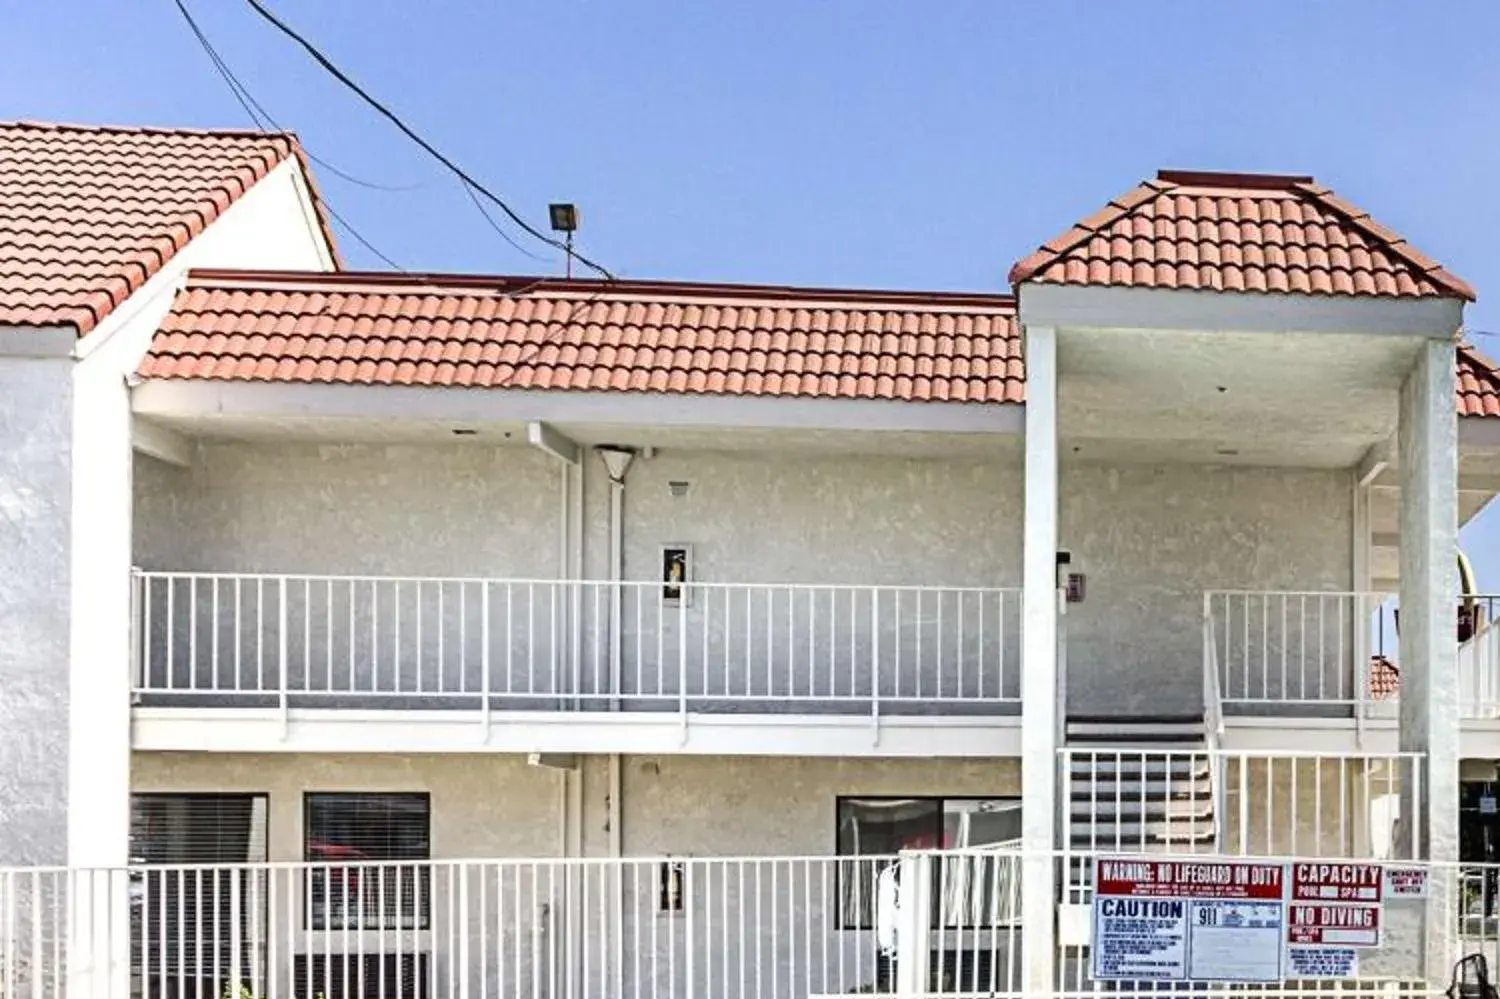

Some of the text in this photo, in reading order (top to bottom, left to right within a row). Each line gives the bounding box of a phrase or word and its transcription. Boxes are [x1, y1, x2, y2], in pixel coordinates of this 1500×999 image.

[1102, 863, 1279, 886] WARNING: NO LIFEGUARD ON DUTY
[1298, 865, 1378, 884] CAPACITY
[1102, 899, 1182, 918] CAUTION
[1199, 907, 1217, 925] 911
[1296, 907, 1315, 925] NO
[1321, 909, 1373, 926] DIVING
